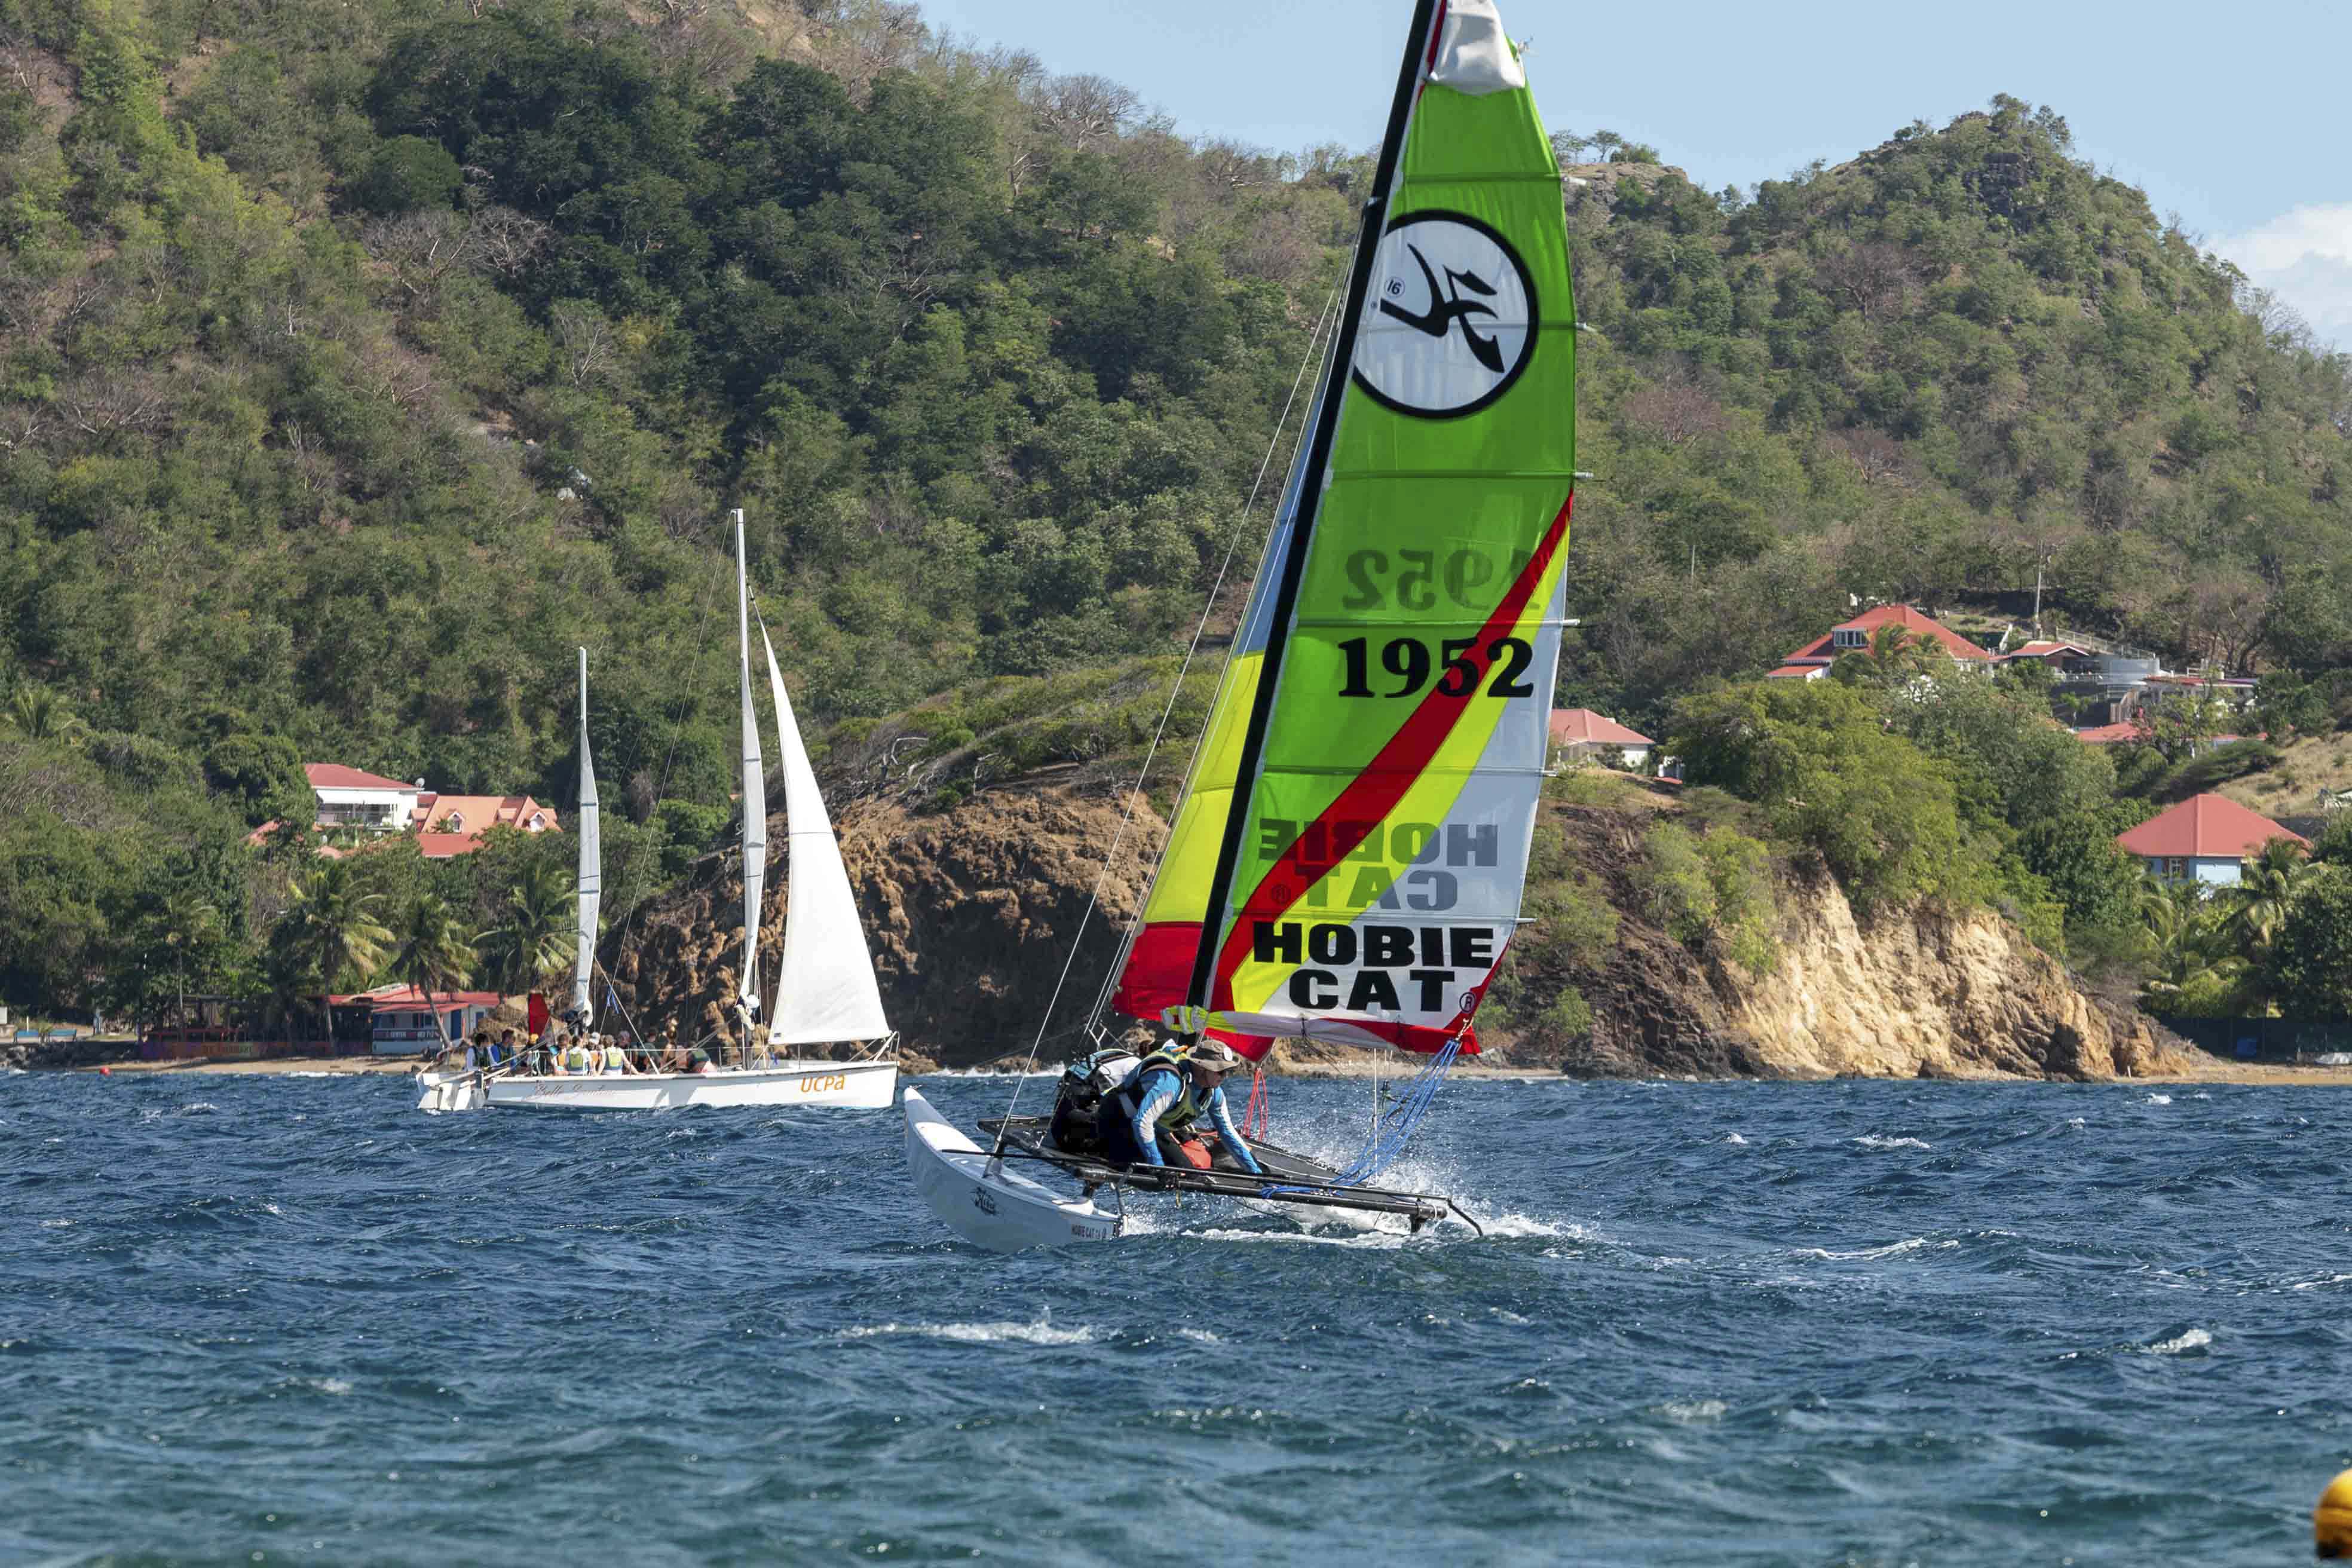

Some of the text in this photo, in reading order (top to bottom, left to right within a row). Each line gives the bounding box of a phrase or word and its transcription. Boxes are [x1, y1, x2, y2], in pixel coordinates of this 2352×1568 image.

[1387, 279, 1401, 295] 16
[1338, 637, 1533, 699] 1952
[1253, 921, 1493, 968] HOBIE
[1290, 969, 1455, 1012] CAT
